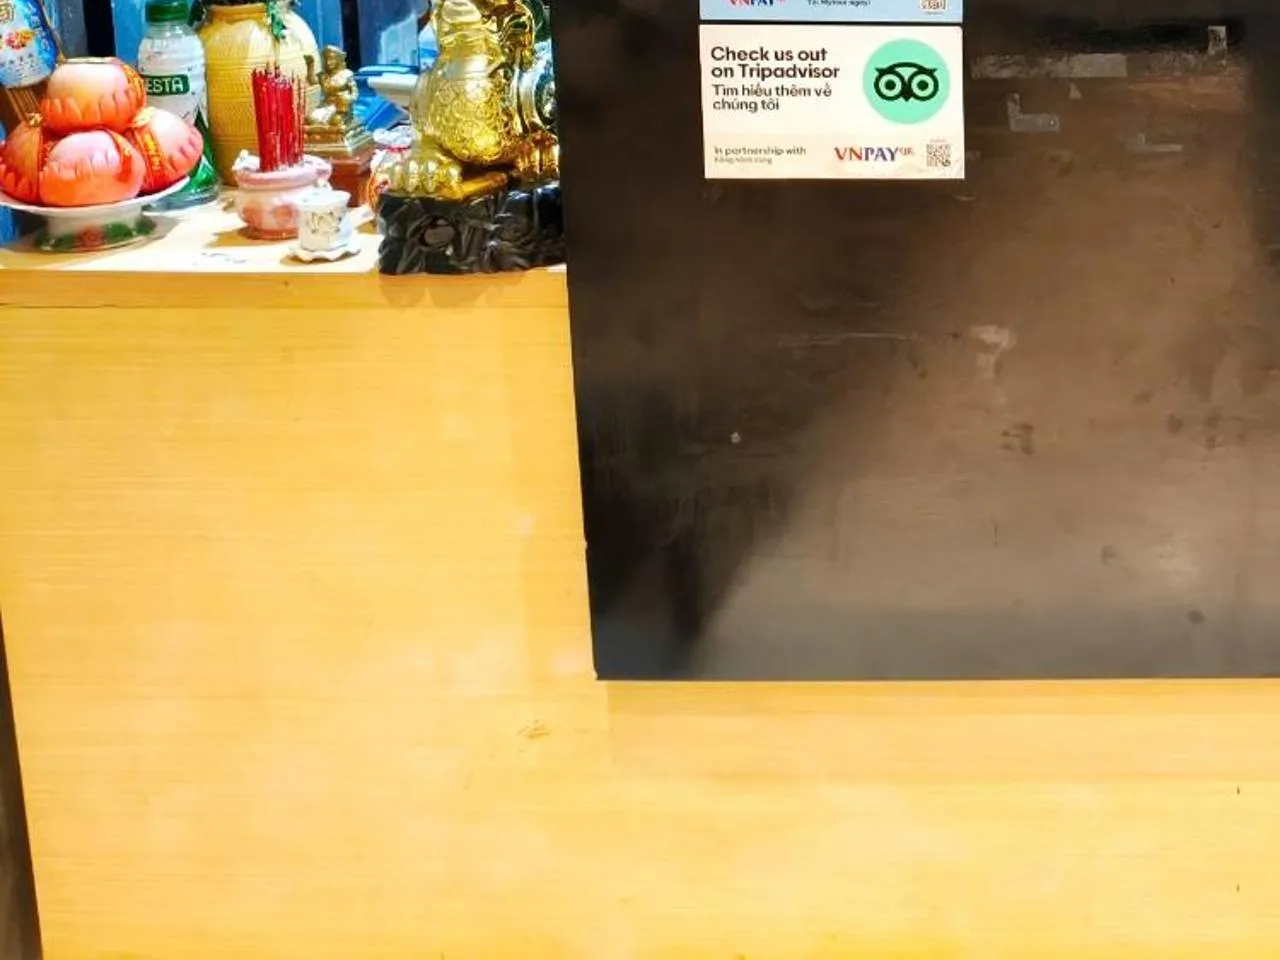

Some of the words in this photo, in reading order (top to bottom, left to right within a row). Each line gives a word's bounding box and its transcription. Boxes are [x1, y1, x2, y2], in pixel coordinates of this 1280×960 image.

[711, 46, 770, 62] Check
[774, 50, 794, 62] us
[798, 47, 828, 62] out
[711, 67, 734, 79] on
[737, 63, 840, 82] Tripadvisor
[146, 77, 184, 93] ESTA
[712, 83, 740, 97] Tìm
[776, 83, 811, 97] thêm
[712, 96, 757, 113] chúng
[761, 97, 780, 111] tôi
